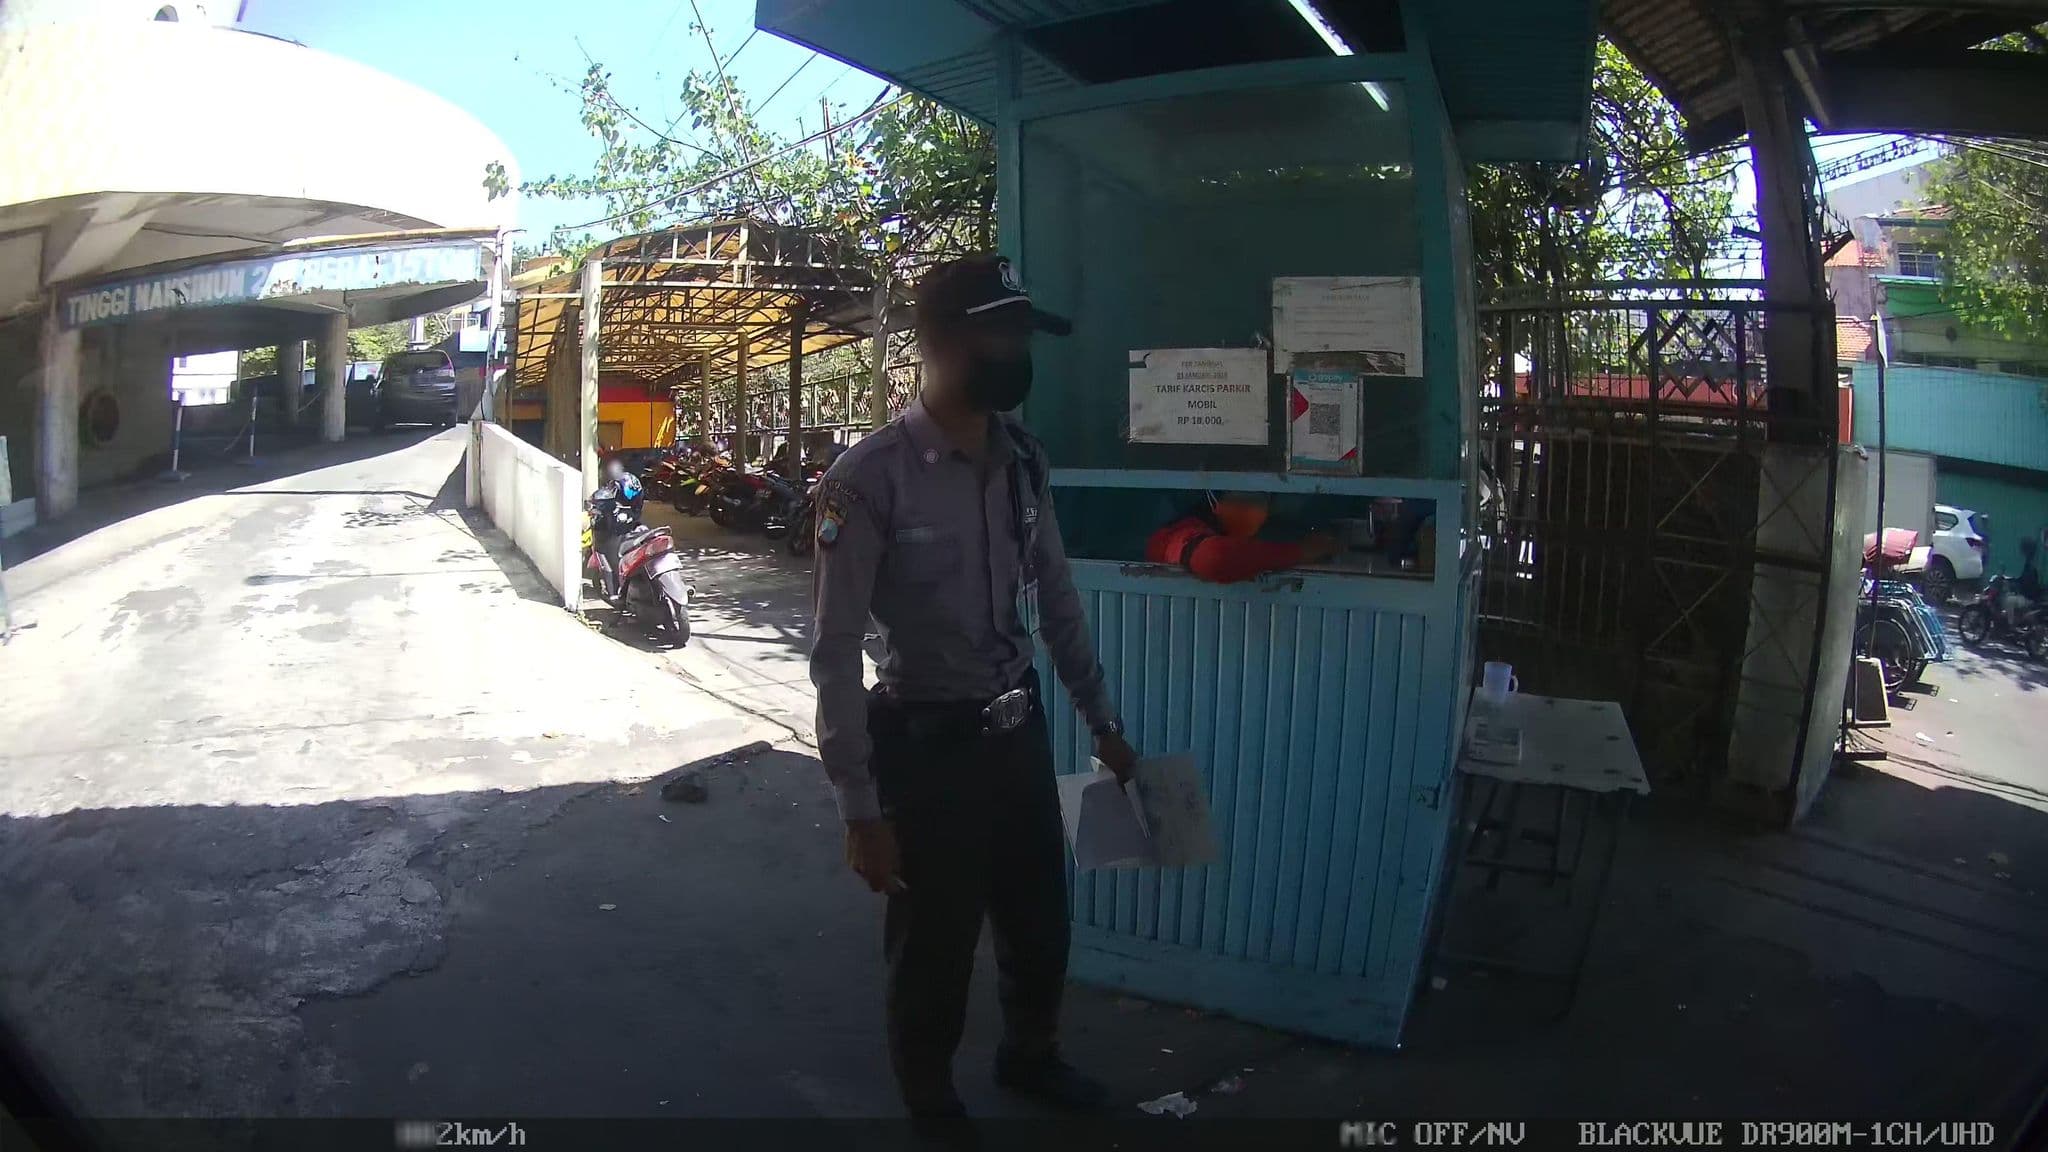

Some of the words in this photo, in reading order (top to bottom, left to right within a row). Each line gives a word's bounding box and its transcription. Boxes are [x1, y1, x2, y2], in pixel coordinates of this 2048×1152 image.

[67, 286, 131, 325] TINGGI
[1155, 384, 1181, 393] TARIF
[1182, 384, 1215, 393] KARCIS
[1216, 384, 1251, 393] PARKIR
[1187, 400, 1217, 409] MOBIL
[1177, 416, 1190, 425] RP
